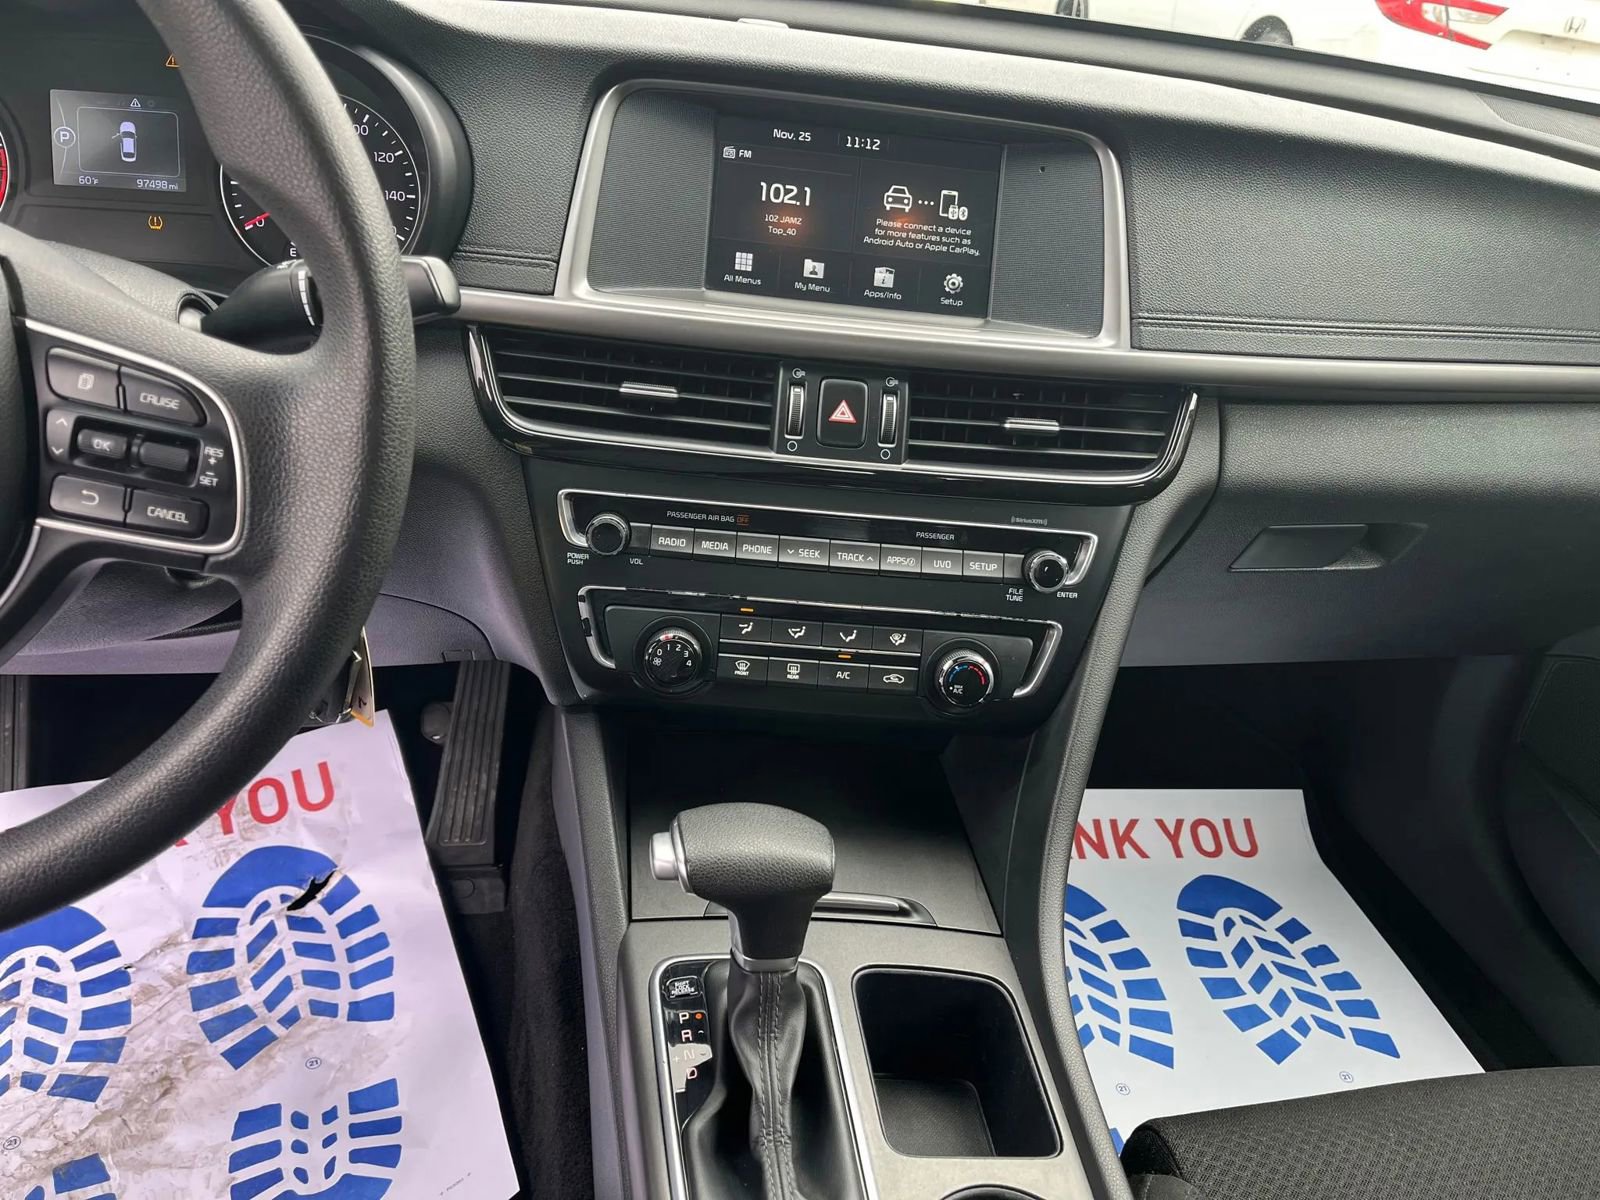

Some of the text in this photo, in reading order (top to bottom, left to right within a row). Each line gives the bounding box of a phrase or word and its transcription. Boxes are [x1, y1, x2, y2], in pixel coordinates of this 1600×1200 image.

[352, 124, 369, 136] 00
[773, 129, 812, 142] Nov. 25
[59, 131, 70, 143] P
[845, 136, 881, 151] 11:12
[373, 152, 395, 163] 120
[738, 149, 752, 159] FM
[384, 190, 406, 201] 140
[759, 181, 811, 207] 102.1
[764, 213, 802, 225] 102 JAMZ
[768, 226, 797, 237] Top_40
[876, 218, 902, 229] Please
[903, 220, 936, 233] connect
[944, 225, 971, 236] device
[874, 227, 972, 245] for more features such as
[863, 236, 894, 248] Android
[895, 239, 914, 249] Auto
[915, 242, 924, 250] or
[925, 242, 948, 253] Apple
[289, 247, 297, 257] E
[723, 274, 761, 286] All Menus
[794, 281, 830, 293] My Menu
[864, 289, 902, 301] Apps/Info
[940, 297, 963, 307] Setup
[139, 392, 181, 410] CRUISE
[92, 439, 112, 452] OK
[204, 446, 224, 458] RES
[199, 475, 218, 487] SET
[146, 505, 190, 524] CANCEL
[666, 510, 707, 521] PASSENGER
[707, 514, 720, 522] AIR
[720, 515, 735, 523] BAG
[658, 536, 686, 547] RADIO
[915, 531, 955, 541] PASSENGER
[701, 540, 729, 551] MEDIA
[742, 543, 773, 555] PHONE
[566, 552, 590, 560] POWER
[798, 548, 821, 559] SEEK
[837, 551, 865, 562] TRACK
[566, 558, 584, 566] PUSH
[629, 557, 644, 565] VOL
[933, 560, 952, 569] UVO
[969, 561, 998, 572] SETUP
[1008, 587, 1024, 596] FILE
[1056, 590, 1078, 600] ENTER
[1005, 594, 1024, 602] TUNE
[656, 648, 663, 656] 0
[675, 644, 682, 652] 2
[683, 650, 689, 658] 3
[686, 659, 692, 667] 4
[734, 669, 750, 677] FRONT
[836, 670, 851, 680] A/C
[1155, 817, 1259, 860] YOU
[679, 1012, 690, 1024] P
[681, 1029, 693, 1042] R
[686, 1067, 698, 1079] D
